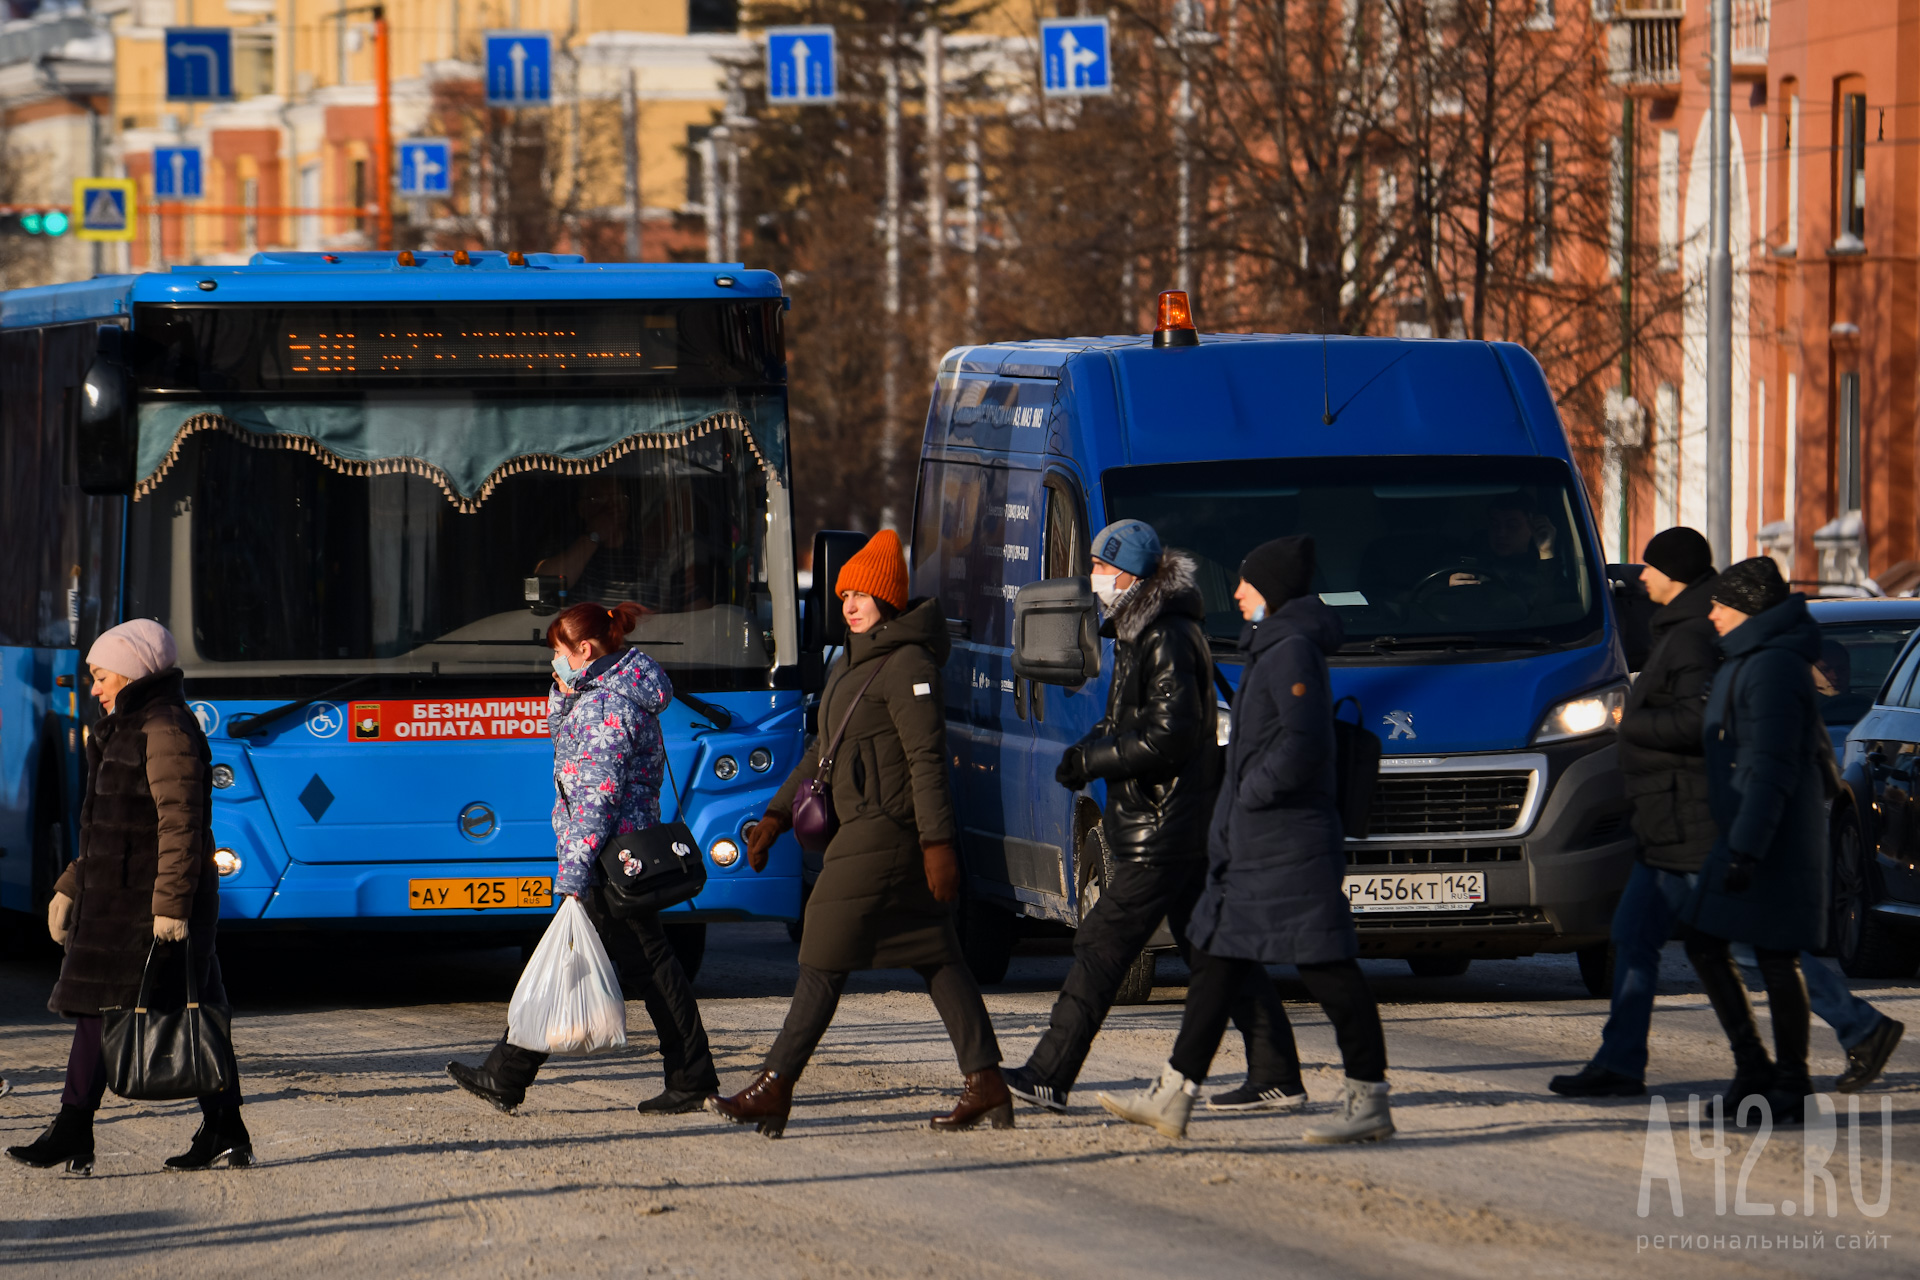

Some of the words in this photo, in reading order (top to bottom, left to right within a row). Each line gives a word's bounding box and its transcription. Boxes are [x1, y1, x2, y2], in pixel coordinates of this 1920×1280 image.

[413, 701, 546, 719] БЕЗНАЛИЧН
[394, 719, 485, 738] ОПЛАТА
[520, 880, 543, 897] 42
[1444, 875, 1478, 892] 142
[463, 882, 506, 904] 125
[523, 897, 540, 905] RUS
